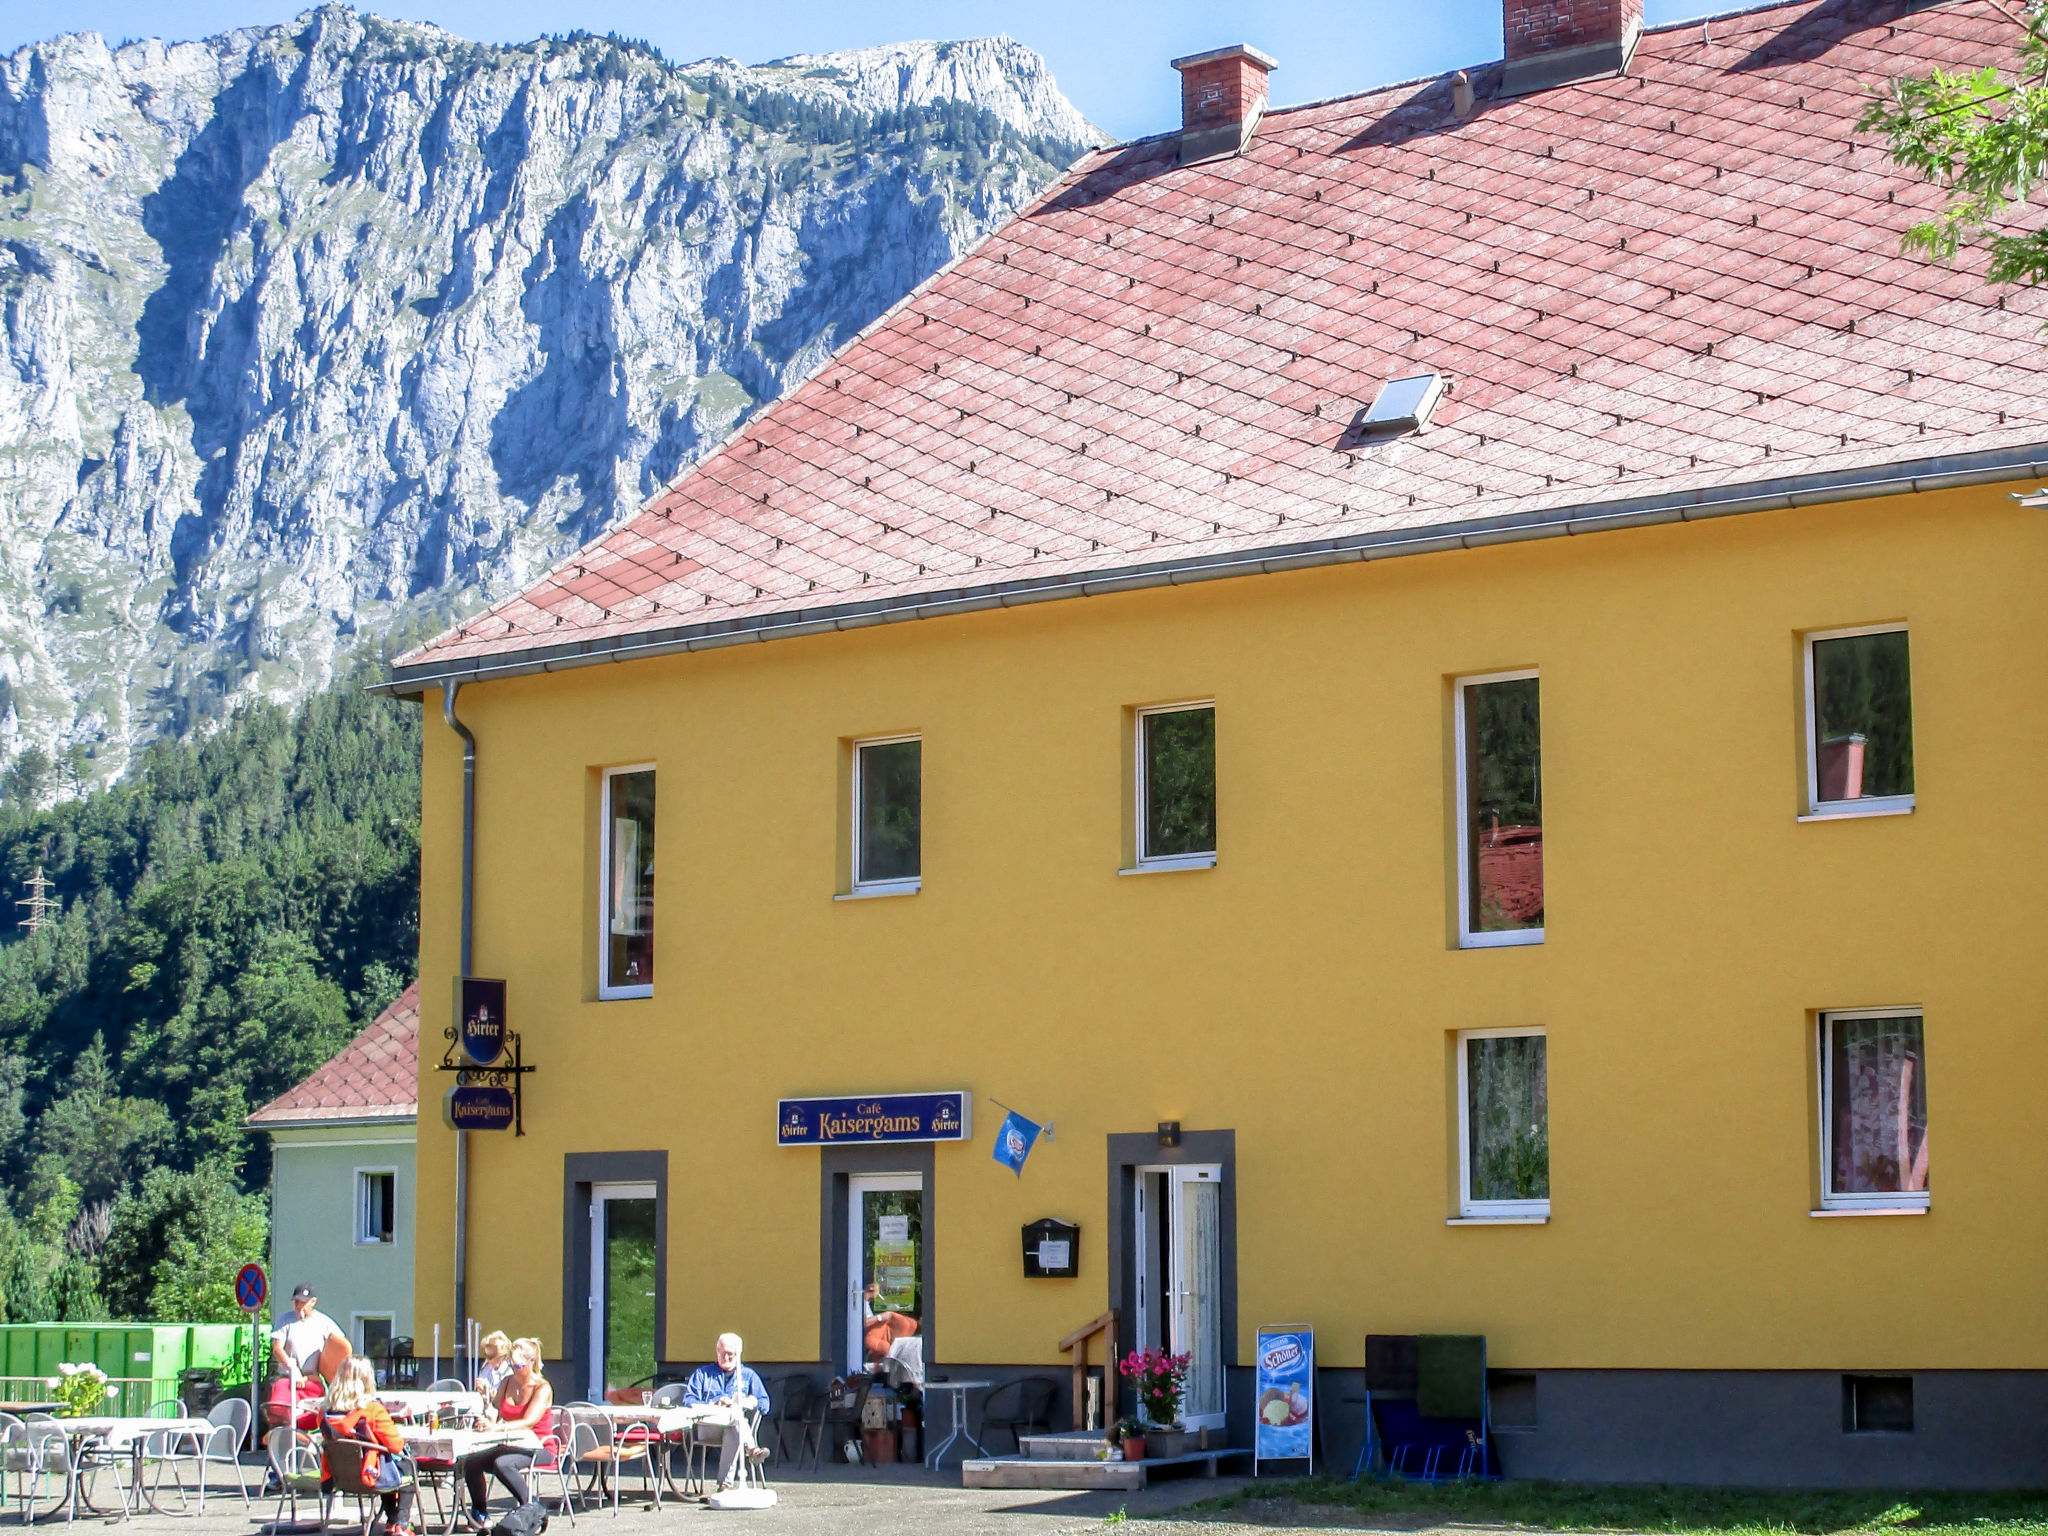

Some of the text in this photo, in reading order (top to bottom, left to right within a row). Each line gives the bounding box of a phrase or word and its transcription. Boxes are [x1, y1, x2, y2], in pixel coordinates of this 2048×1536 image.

[467, 1019, 499, 1037] Hirter
[454, 1101, 511, 1119] Kaisergams
[857, 1103, 882, 1114] Café
[781, 1123, 808, 1137] Hirter
[819, 1112, 920, 1139] Kaisergams
[931, 1118, 960, 1133] Hirter
